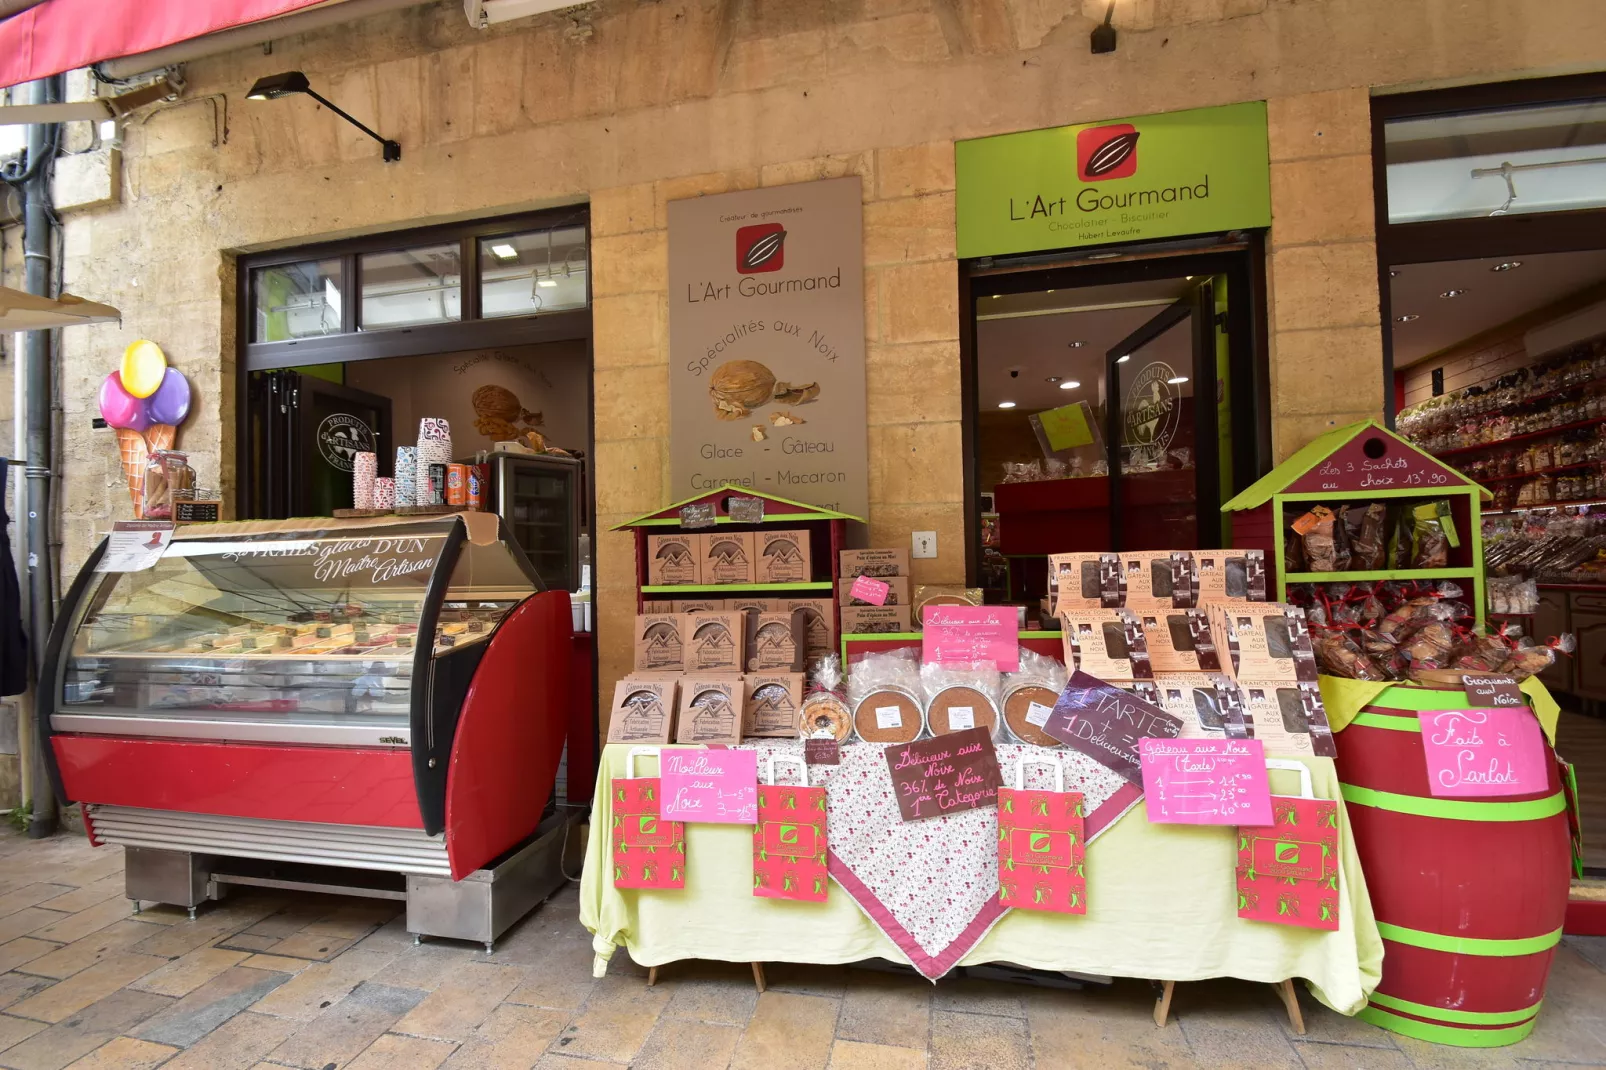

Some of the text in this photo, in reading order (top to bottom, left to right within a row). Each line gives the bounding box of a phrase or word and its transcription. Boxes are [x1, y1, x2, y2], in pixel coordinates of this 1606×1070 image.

[1010, 174, 1208, 220] L'Art Gourmand
[760, 207, 803, 217] gourmandises
[1049, 211, 1170, 232] Chocolatier Biscuitier
[1078, 228, 1141, 240] Hubert Levaufre
[688, 267, 840, 302] L'Art Gourmand
[687, 320, 840, 376] Spécialités aux Noix
[1132, 366, 1170, 398] PRODUITS
[1127, 398, 1173, 427] d'ARTISANS
[700, 444, 743, 460] Glace
[782, 436, 834, 454] Gâteau
[1320, 457, 1408, 475] Les 3 Sachets
[690, 472, 755, 490] Caramel
[778, 470, 846, 485] Macaron
[1360, 474, 1394, 486] choix
[314, 535, 372, 566] glaces
[372, 538, 430, 554] D'UN
[314, 554, 434, 584] Maître Artisan
[1494, 694, 1520, 705] Noix
[1096, 690, 1166, 737] TARTE
[1432, 712, 1511, 746] Faits à
[894, 745, 952, 770] Délicieux
[1145, 742, 1188, 763] Gâteau
[1222, 741, 1249, 754] Noix
[924, 762, 955, 777] Noix
[1439, 750, 1517, 788] Sarlat
[690, 780, 714, 788] aux
[900, 768, 984, 796] 36% de Noix
[1156, 777, 1163, 787] 1
[666, 788, 702, 814] Noix
[1160, 791, 1166, 800] 2
[717, 802, 726, 815] 3
[1162, 806, 1168, 816] 4
